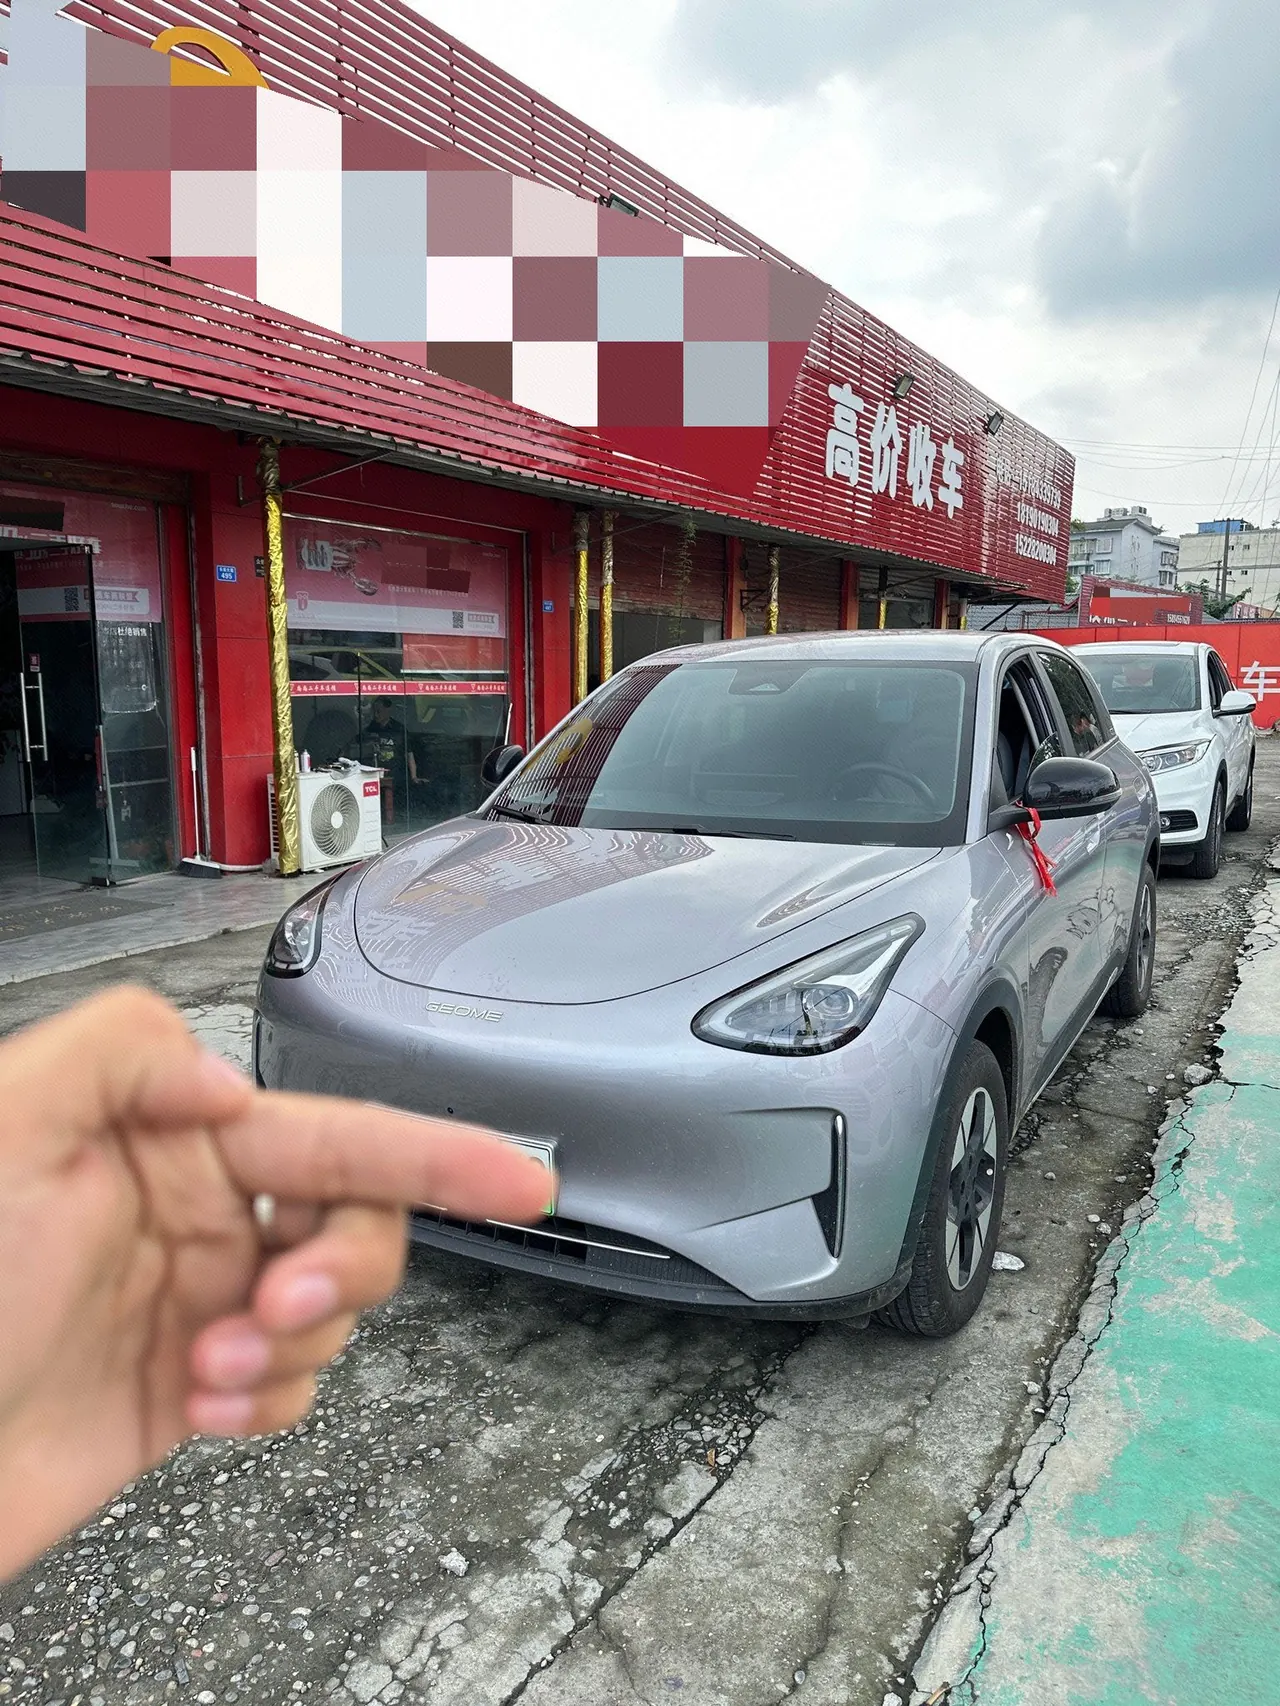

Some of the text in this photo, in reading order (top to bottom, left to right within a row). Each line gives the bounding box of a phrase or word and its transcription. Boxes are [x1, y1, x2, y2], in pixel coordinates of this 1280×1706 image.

[826, 383, 964, 519] 高价收车
[365, 785, 378, 793] TCL
[425, 1001, 504, 1023] GEOME
